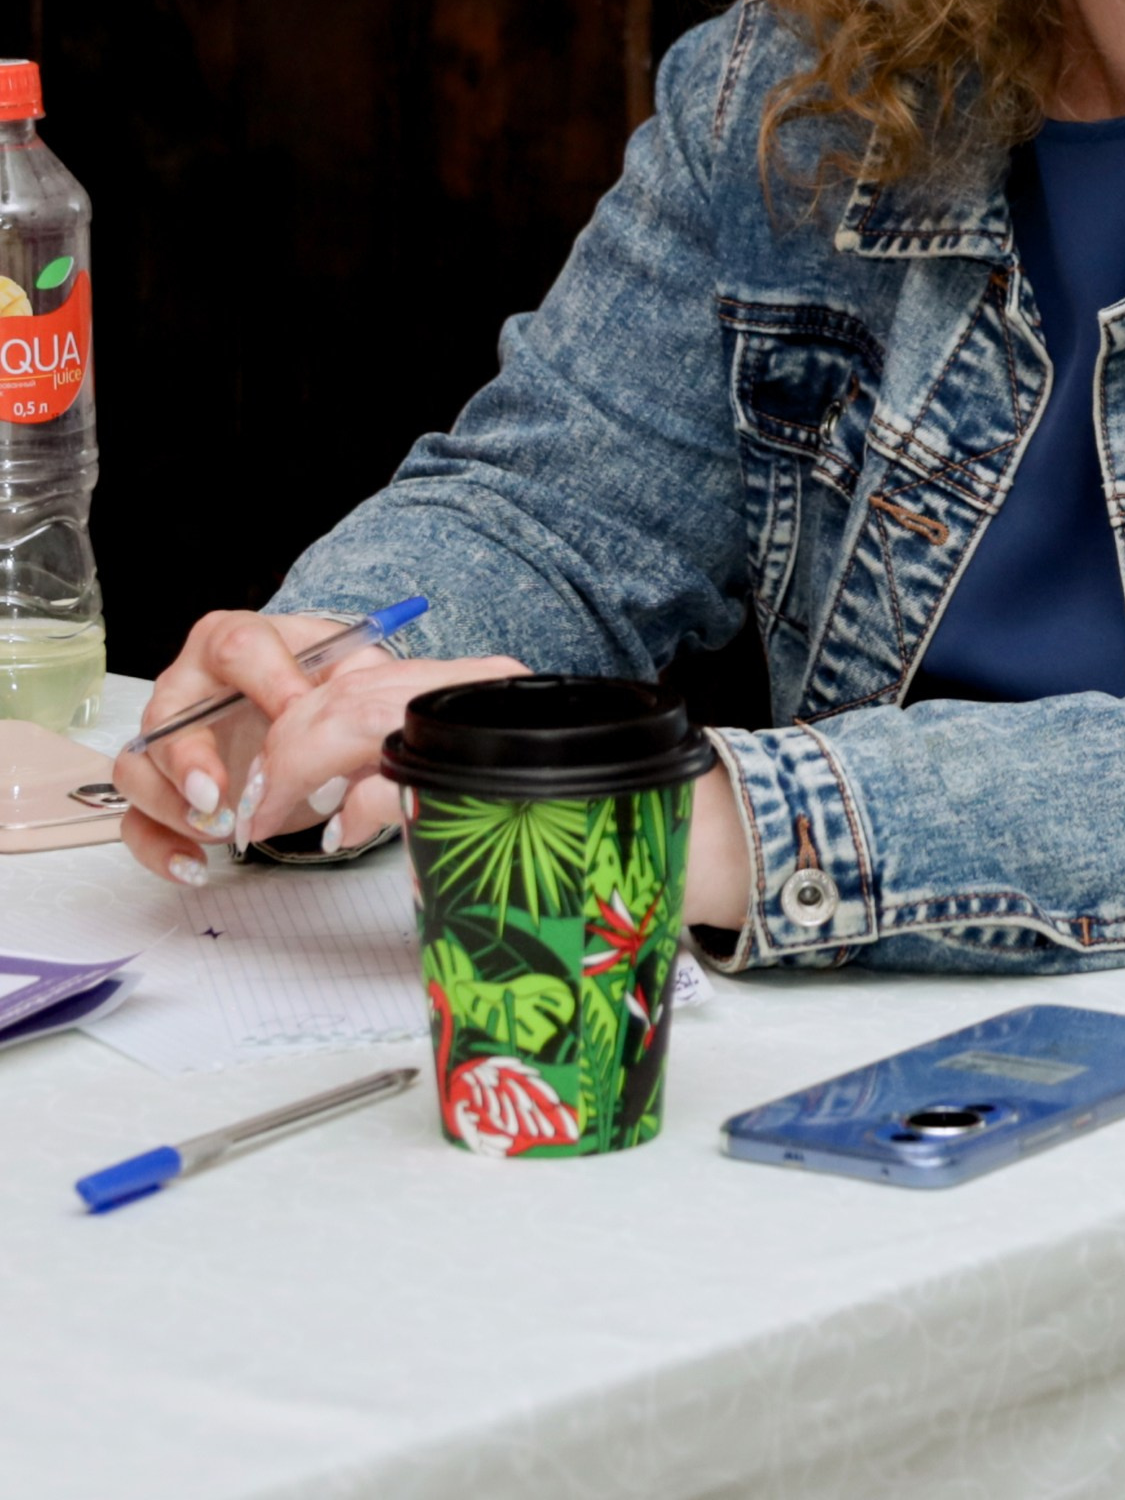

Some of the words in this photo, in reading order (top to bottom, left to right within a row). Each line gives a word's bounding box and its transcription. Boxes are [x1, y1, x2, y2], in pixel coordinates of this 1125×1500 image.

[53, 367, 82, 391] juice
[13, 401, 36, 417] 0,5
[39, 402, 48, 414] л
